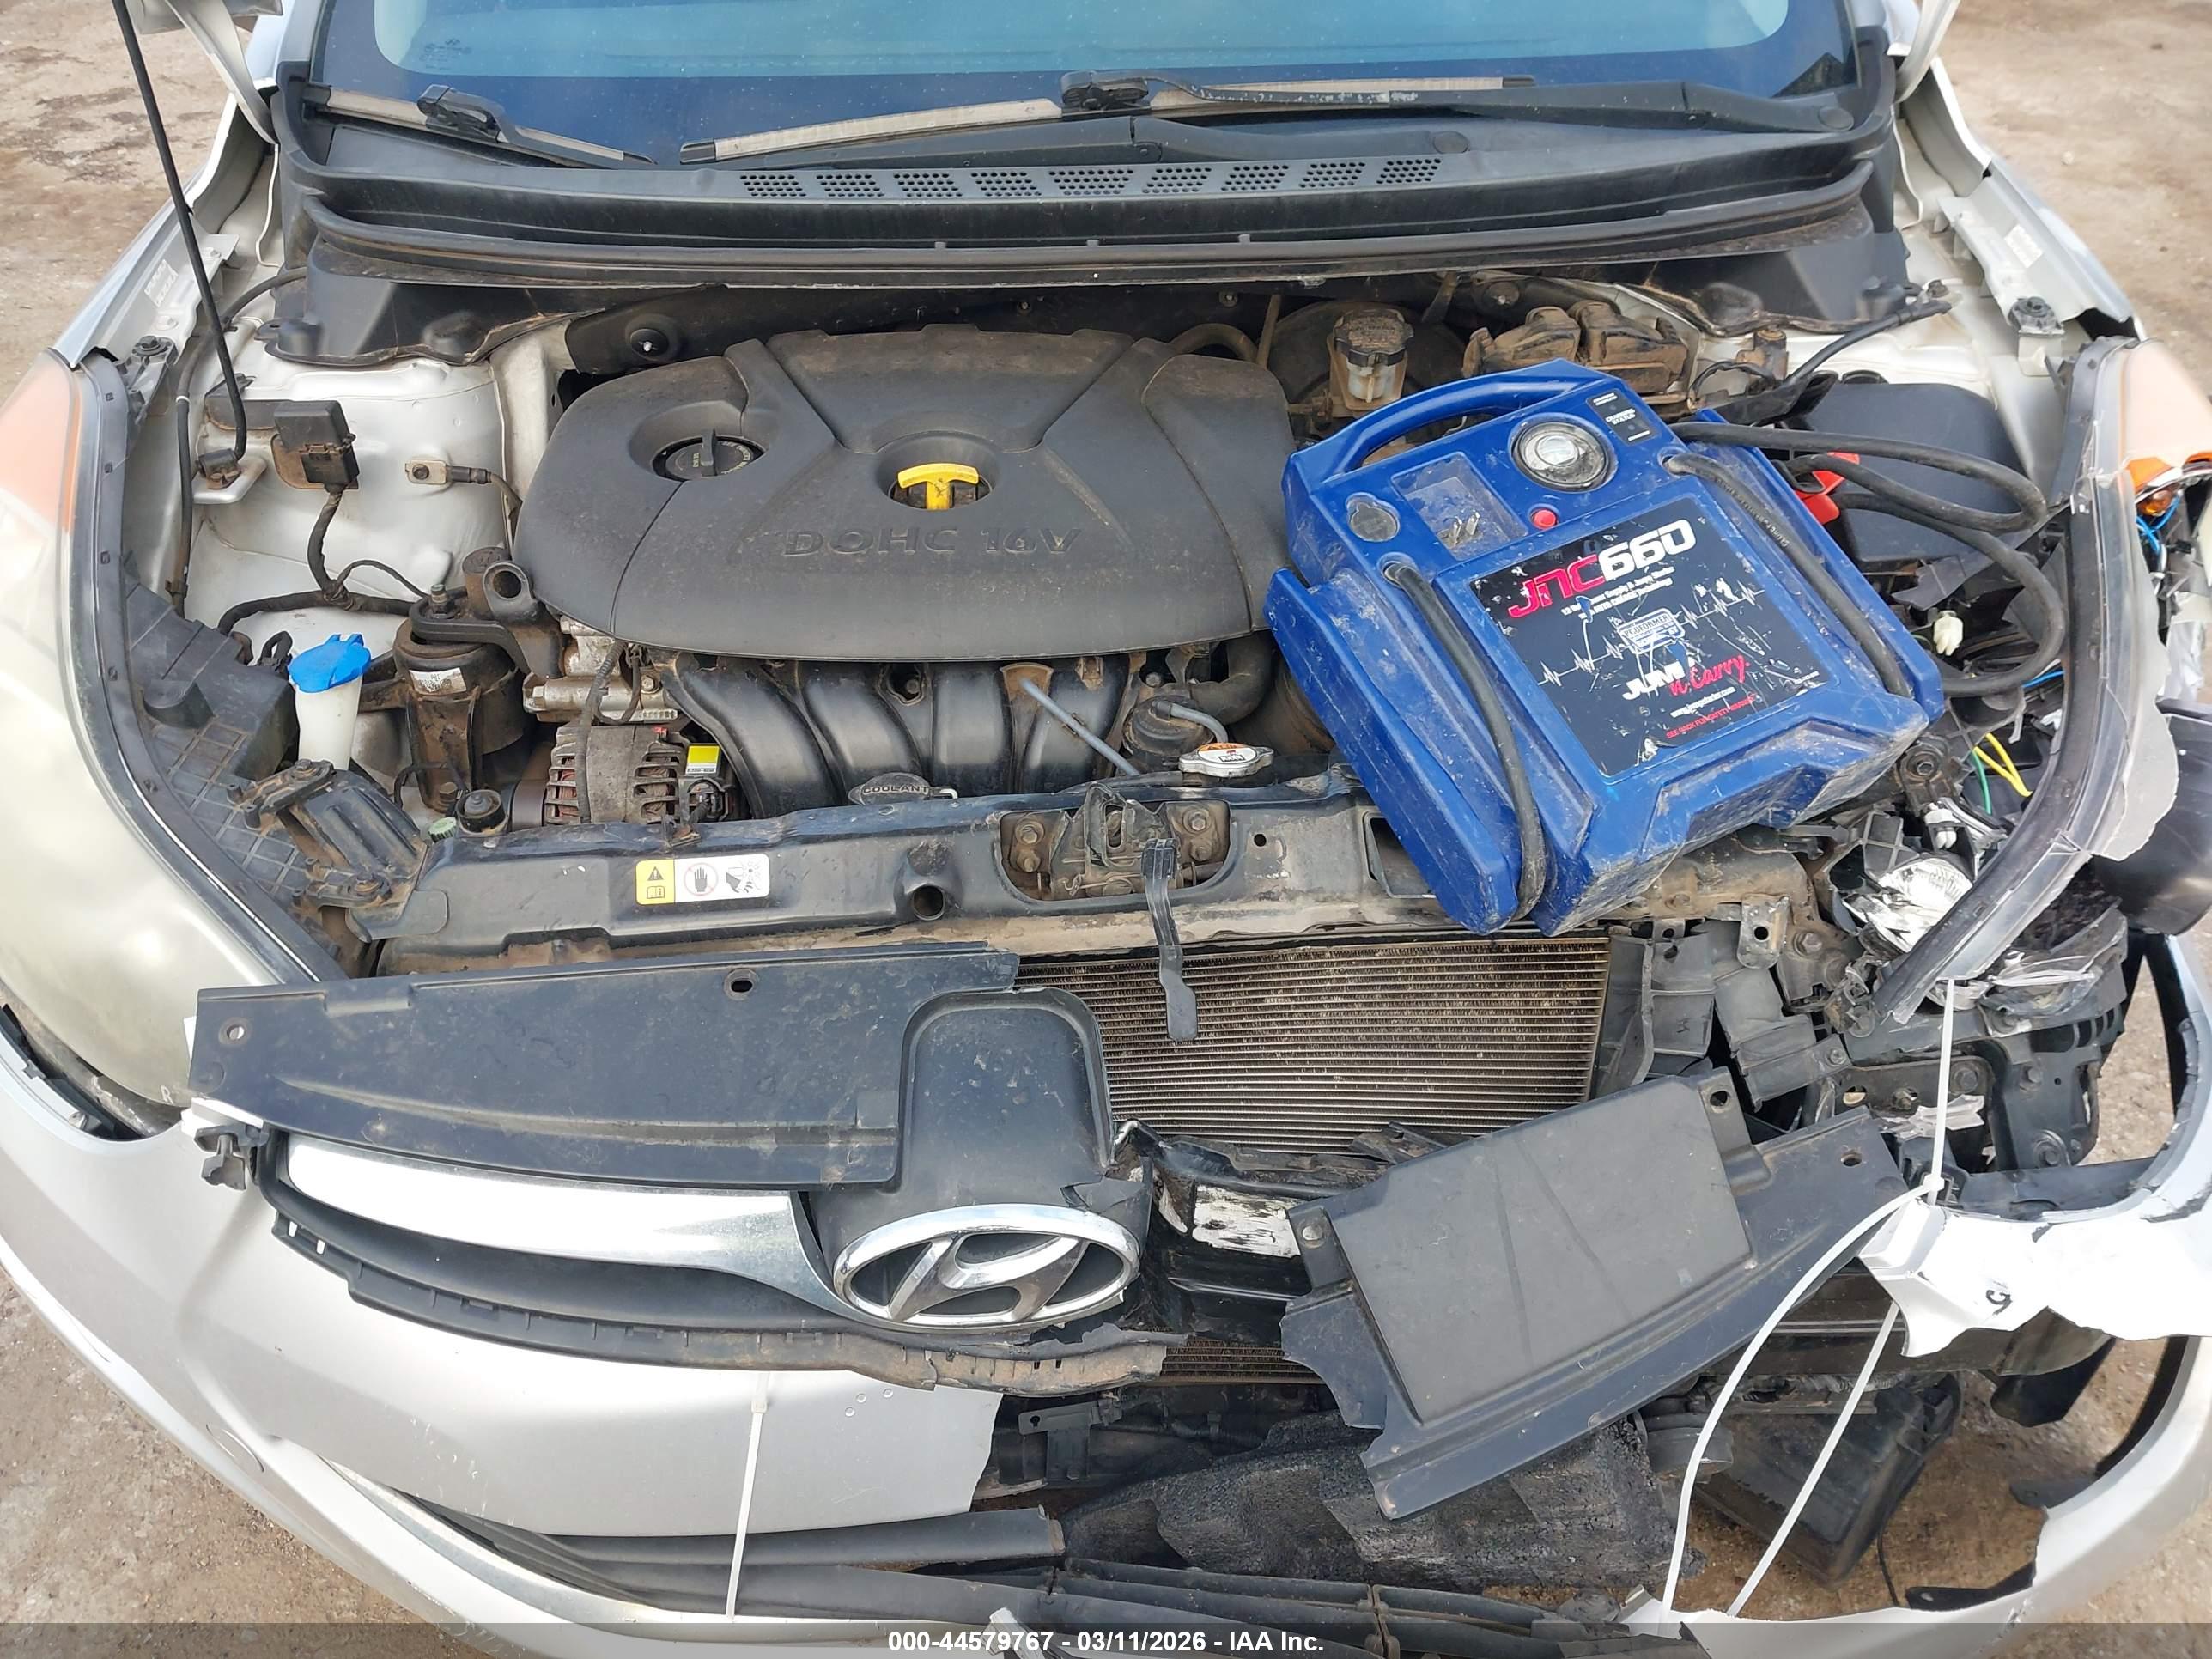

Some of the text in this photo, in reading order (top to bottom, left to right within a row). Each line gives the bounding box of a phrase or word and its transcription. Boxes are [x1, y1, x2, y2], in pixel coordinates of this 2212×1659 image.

[784, 527, 1082, 556] DOHC 16V
[1622, 658, 1695, 700] JUM
[862, 784, 928, 795] COOLANT
[161, 1085, 173, 1104] R
